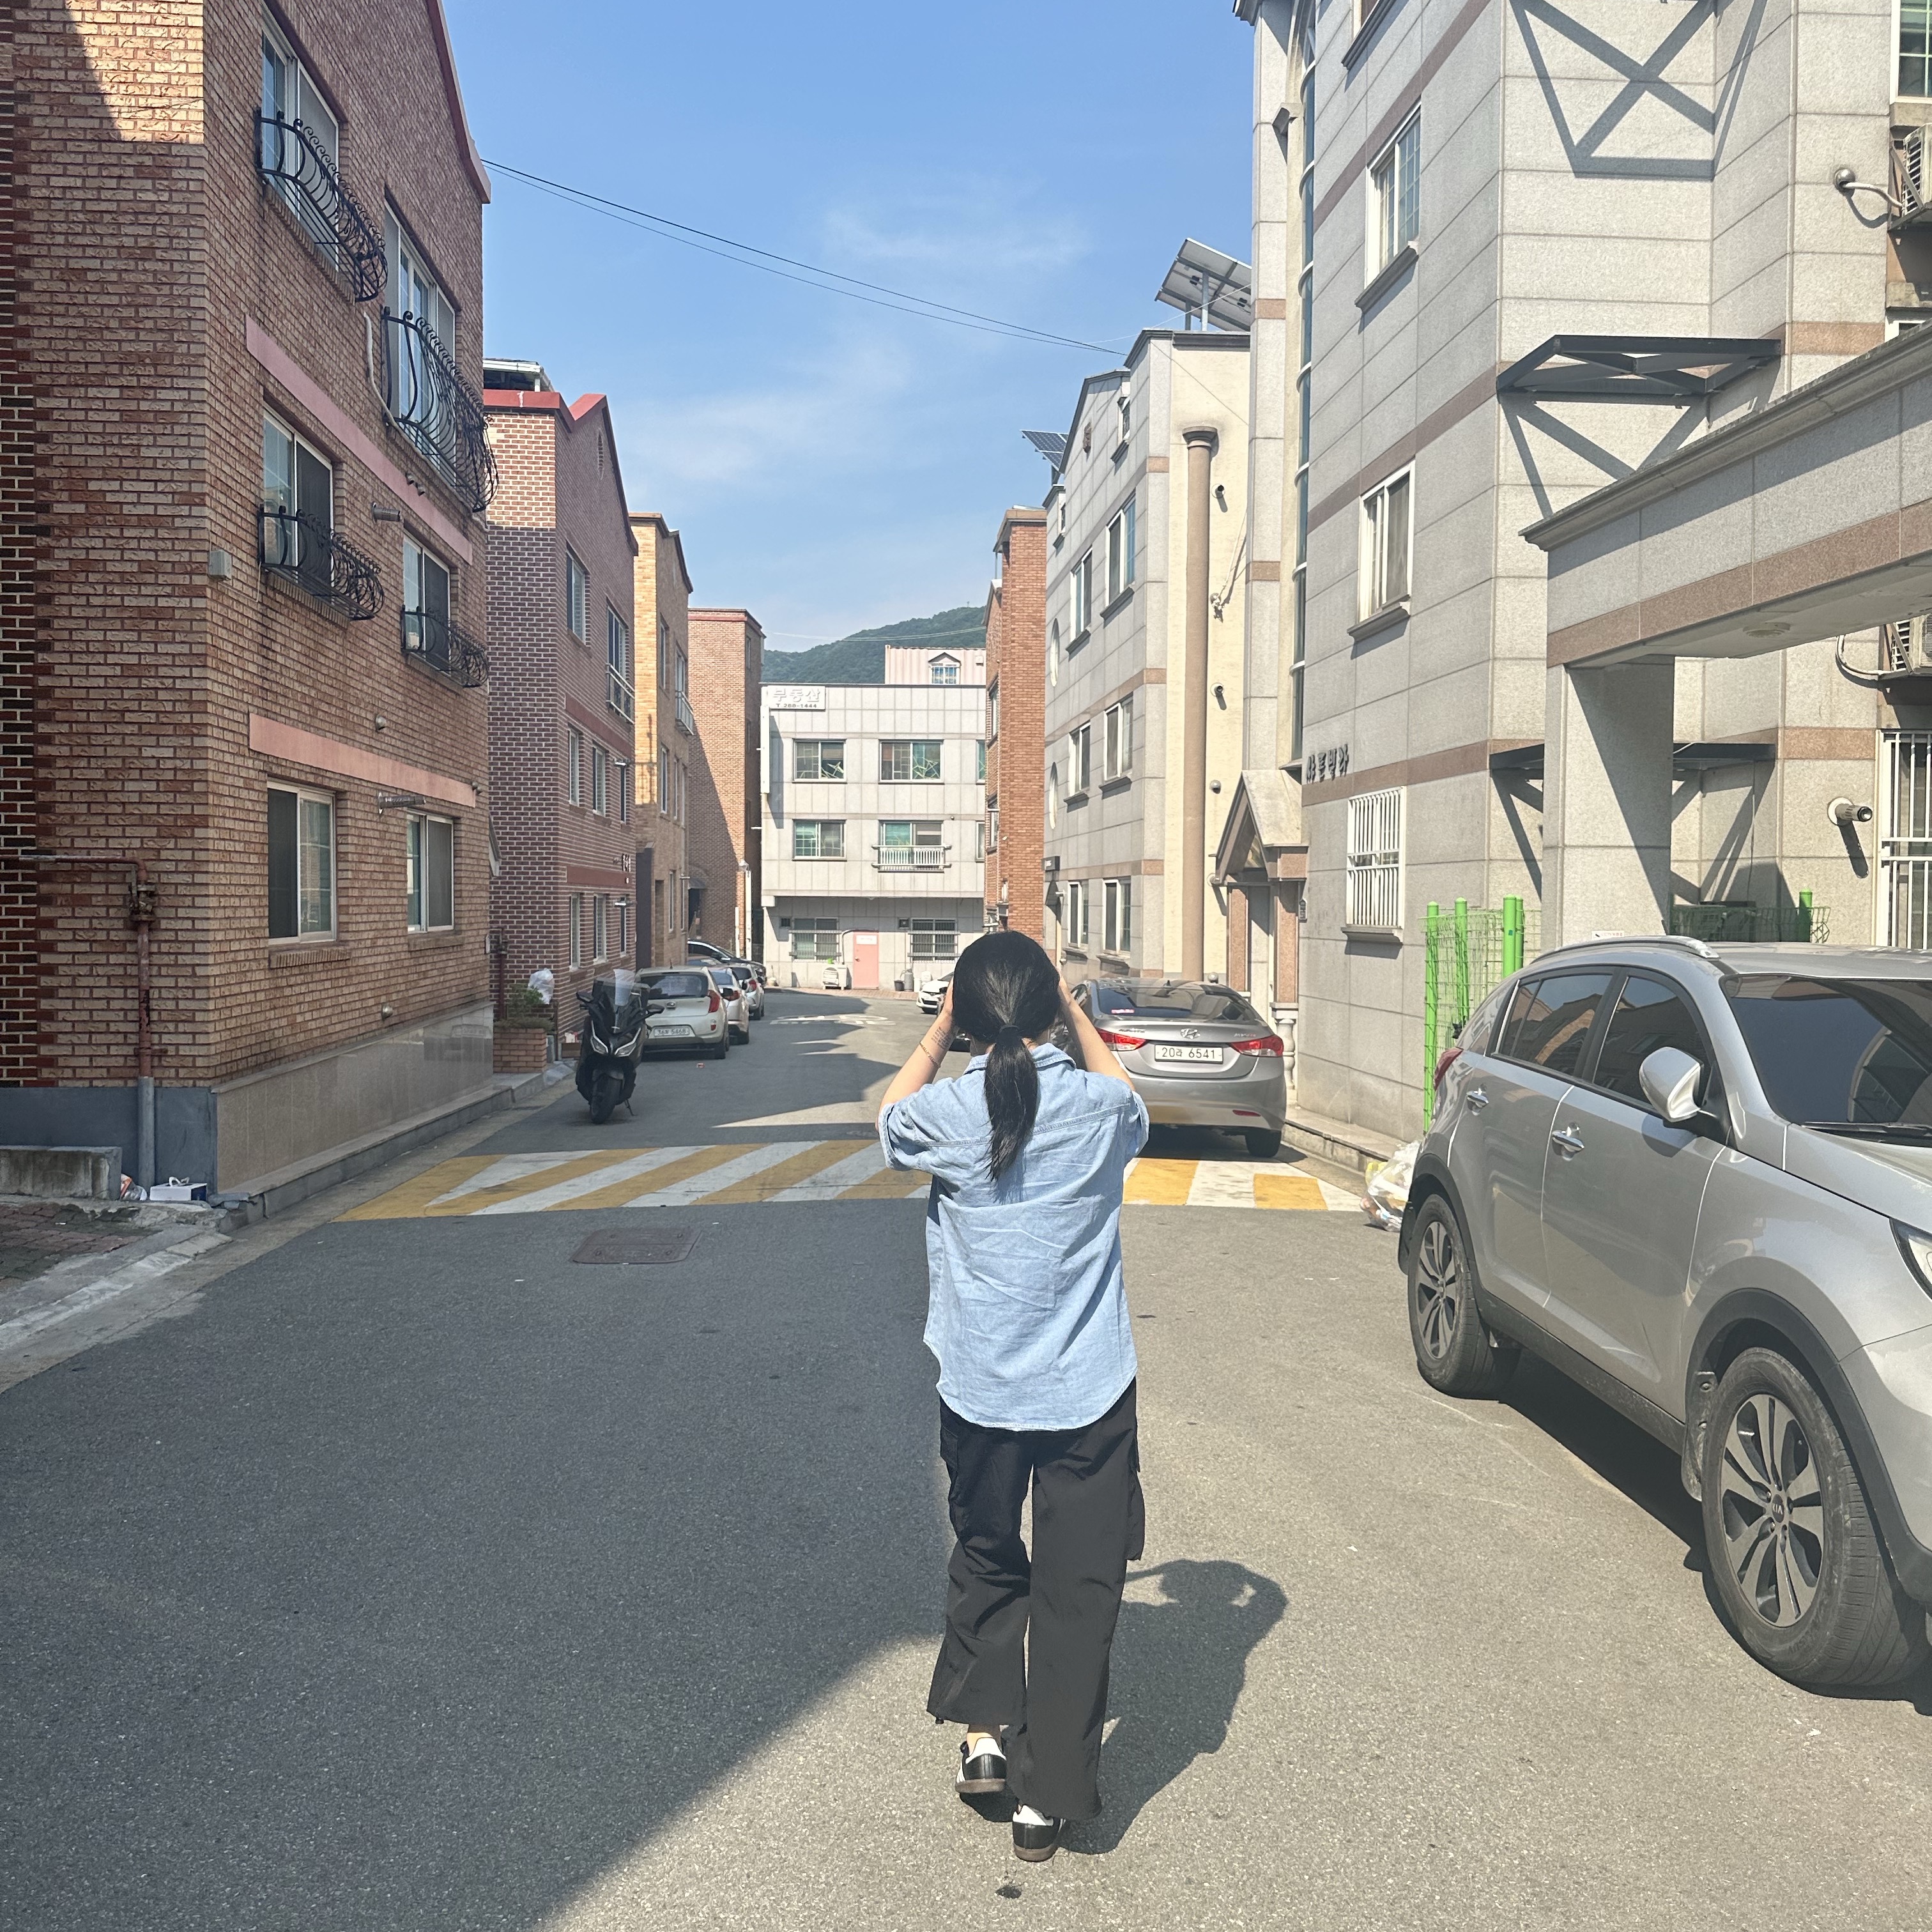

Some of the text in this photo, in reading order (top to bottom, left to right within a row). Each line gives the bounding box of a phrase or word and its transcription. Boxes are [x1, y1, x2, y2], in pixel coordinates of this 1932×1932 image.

[772, 687, 821, 703] 부동산
[1162, 1047, 1215, 1059] 20라 6541
